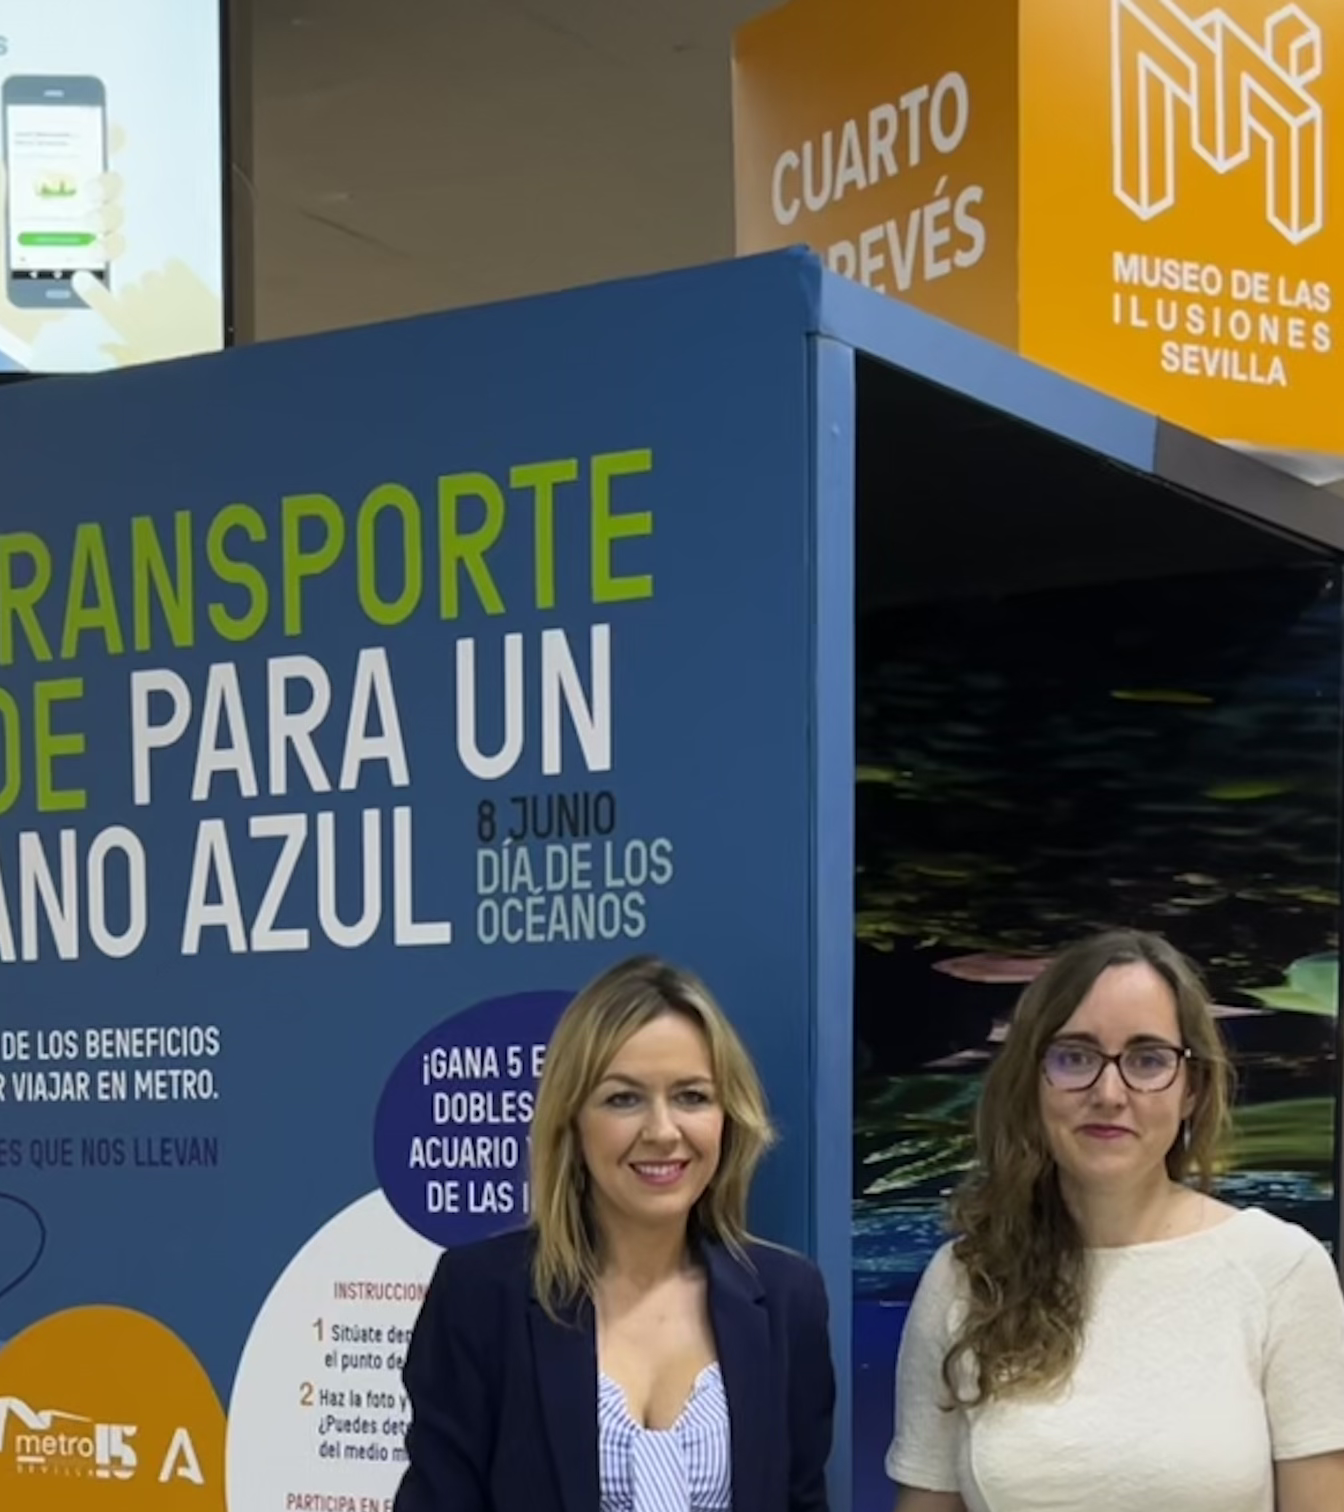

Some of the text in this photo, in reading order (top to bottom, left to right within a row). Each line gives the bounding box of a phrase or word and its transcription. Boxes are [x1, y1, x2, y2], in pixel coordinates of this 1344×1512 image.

[771, 71, 969, 225] CUARTO
[1113, 251, 1331, 313] MUSEO DE LAS
[1160, 340, 1287, 388] SEVILLA
[129, 646, 410, 805] PARA
[454, 623, 612, 779] UN
[477, 790, 616, 844] 8 JUNIO
[181, 806, 451, 956] AZUL
[477, 837, 674, 895] DÍA DE LOS
[477, 886, 646, 945] OCÉANOS
[2, 1031, 30, 1062] DE
[37, 1030, 78, 1061] LOS
[86, 1026, 221, 1060] BENEFICIOS
[422, 1046, 499, 1086] ¡GANA
[507, 1046, 522, 1076] 5
[11, 1071, 90, 1102] VIAJAR
[98, 1070, 126, 1101] EN
[134, 1069, 219, 1100] METRO.
[434, 1092, 534, 1124] DOBLES
[30, 1138, 73, 1170] QUE
[81, 1137, 125, 1167] NOS
[133, 1136, 219, 1167] LLEVAN
[409, 1136, 518, 1169] ACUARIO
[427, 1182, 459, 1214] DE
[467, 1181, 513, 1212] LAS
[312, 1317, 324, 1342] 1
[331, 1323, 383, 1343] Sitúate
[325, 1349, 337, 1368] el
[341, 1353, 383, 1373] punto
[299, 1381, 315, 1407] 2
[319, 1389, 345, 1408] Haz
[350, 1390, 362, 1408] la
[366, 1390, 395, 1409] foto
[318, 1414, 377, 1436] ¿Puedes
[15, 1432, 94, 1459] metro
[319, 1441, 340, 1459] del
[344, 1443, 388, 1463] medio
